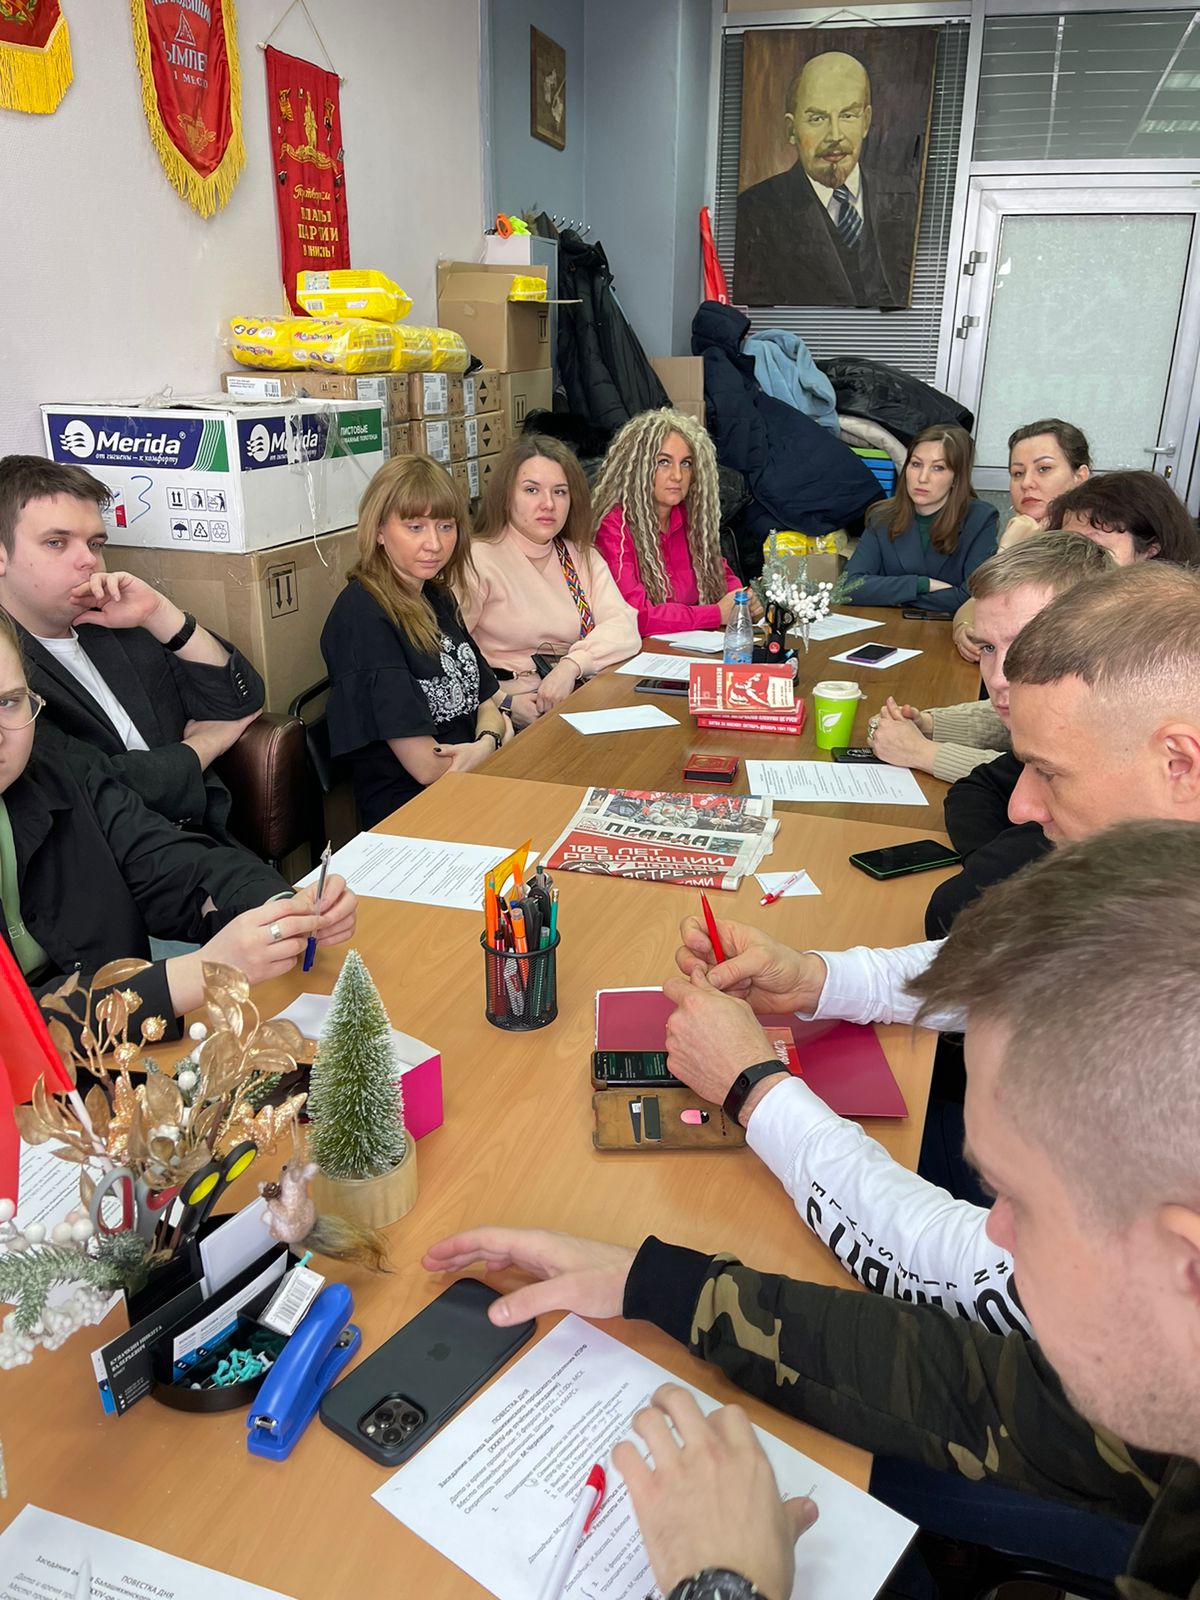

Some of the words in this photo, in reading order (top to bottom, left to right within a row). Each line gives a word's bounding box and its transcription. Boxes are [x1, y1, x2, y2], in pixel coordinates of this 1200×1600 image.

[183, 73, 209, 88] МЕСО
[97, 430, 182, 455] Merida
[604, 821, 709, 847] ПРАВДА
[563, 852, 725, 865] РЕВОЛЮЦИИ
[568, 844, 608, 854] 105
[618, 846, 663, 856] ЛЕТ
[491, 1398, 518, 1424] ПОВЕСТКА
[516, 1387, 530, 1401] ДНЯ
[120, 1574, 157, 1594] ПОВЕСТКА
[156, 1587, 175, 1600] ДНЯ
